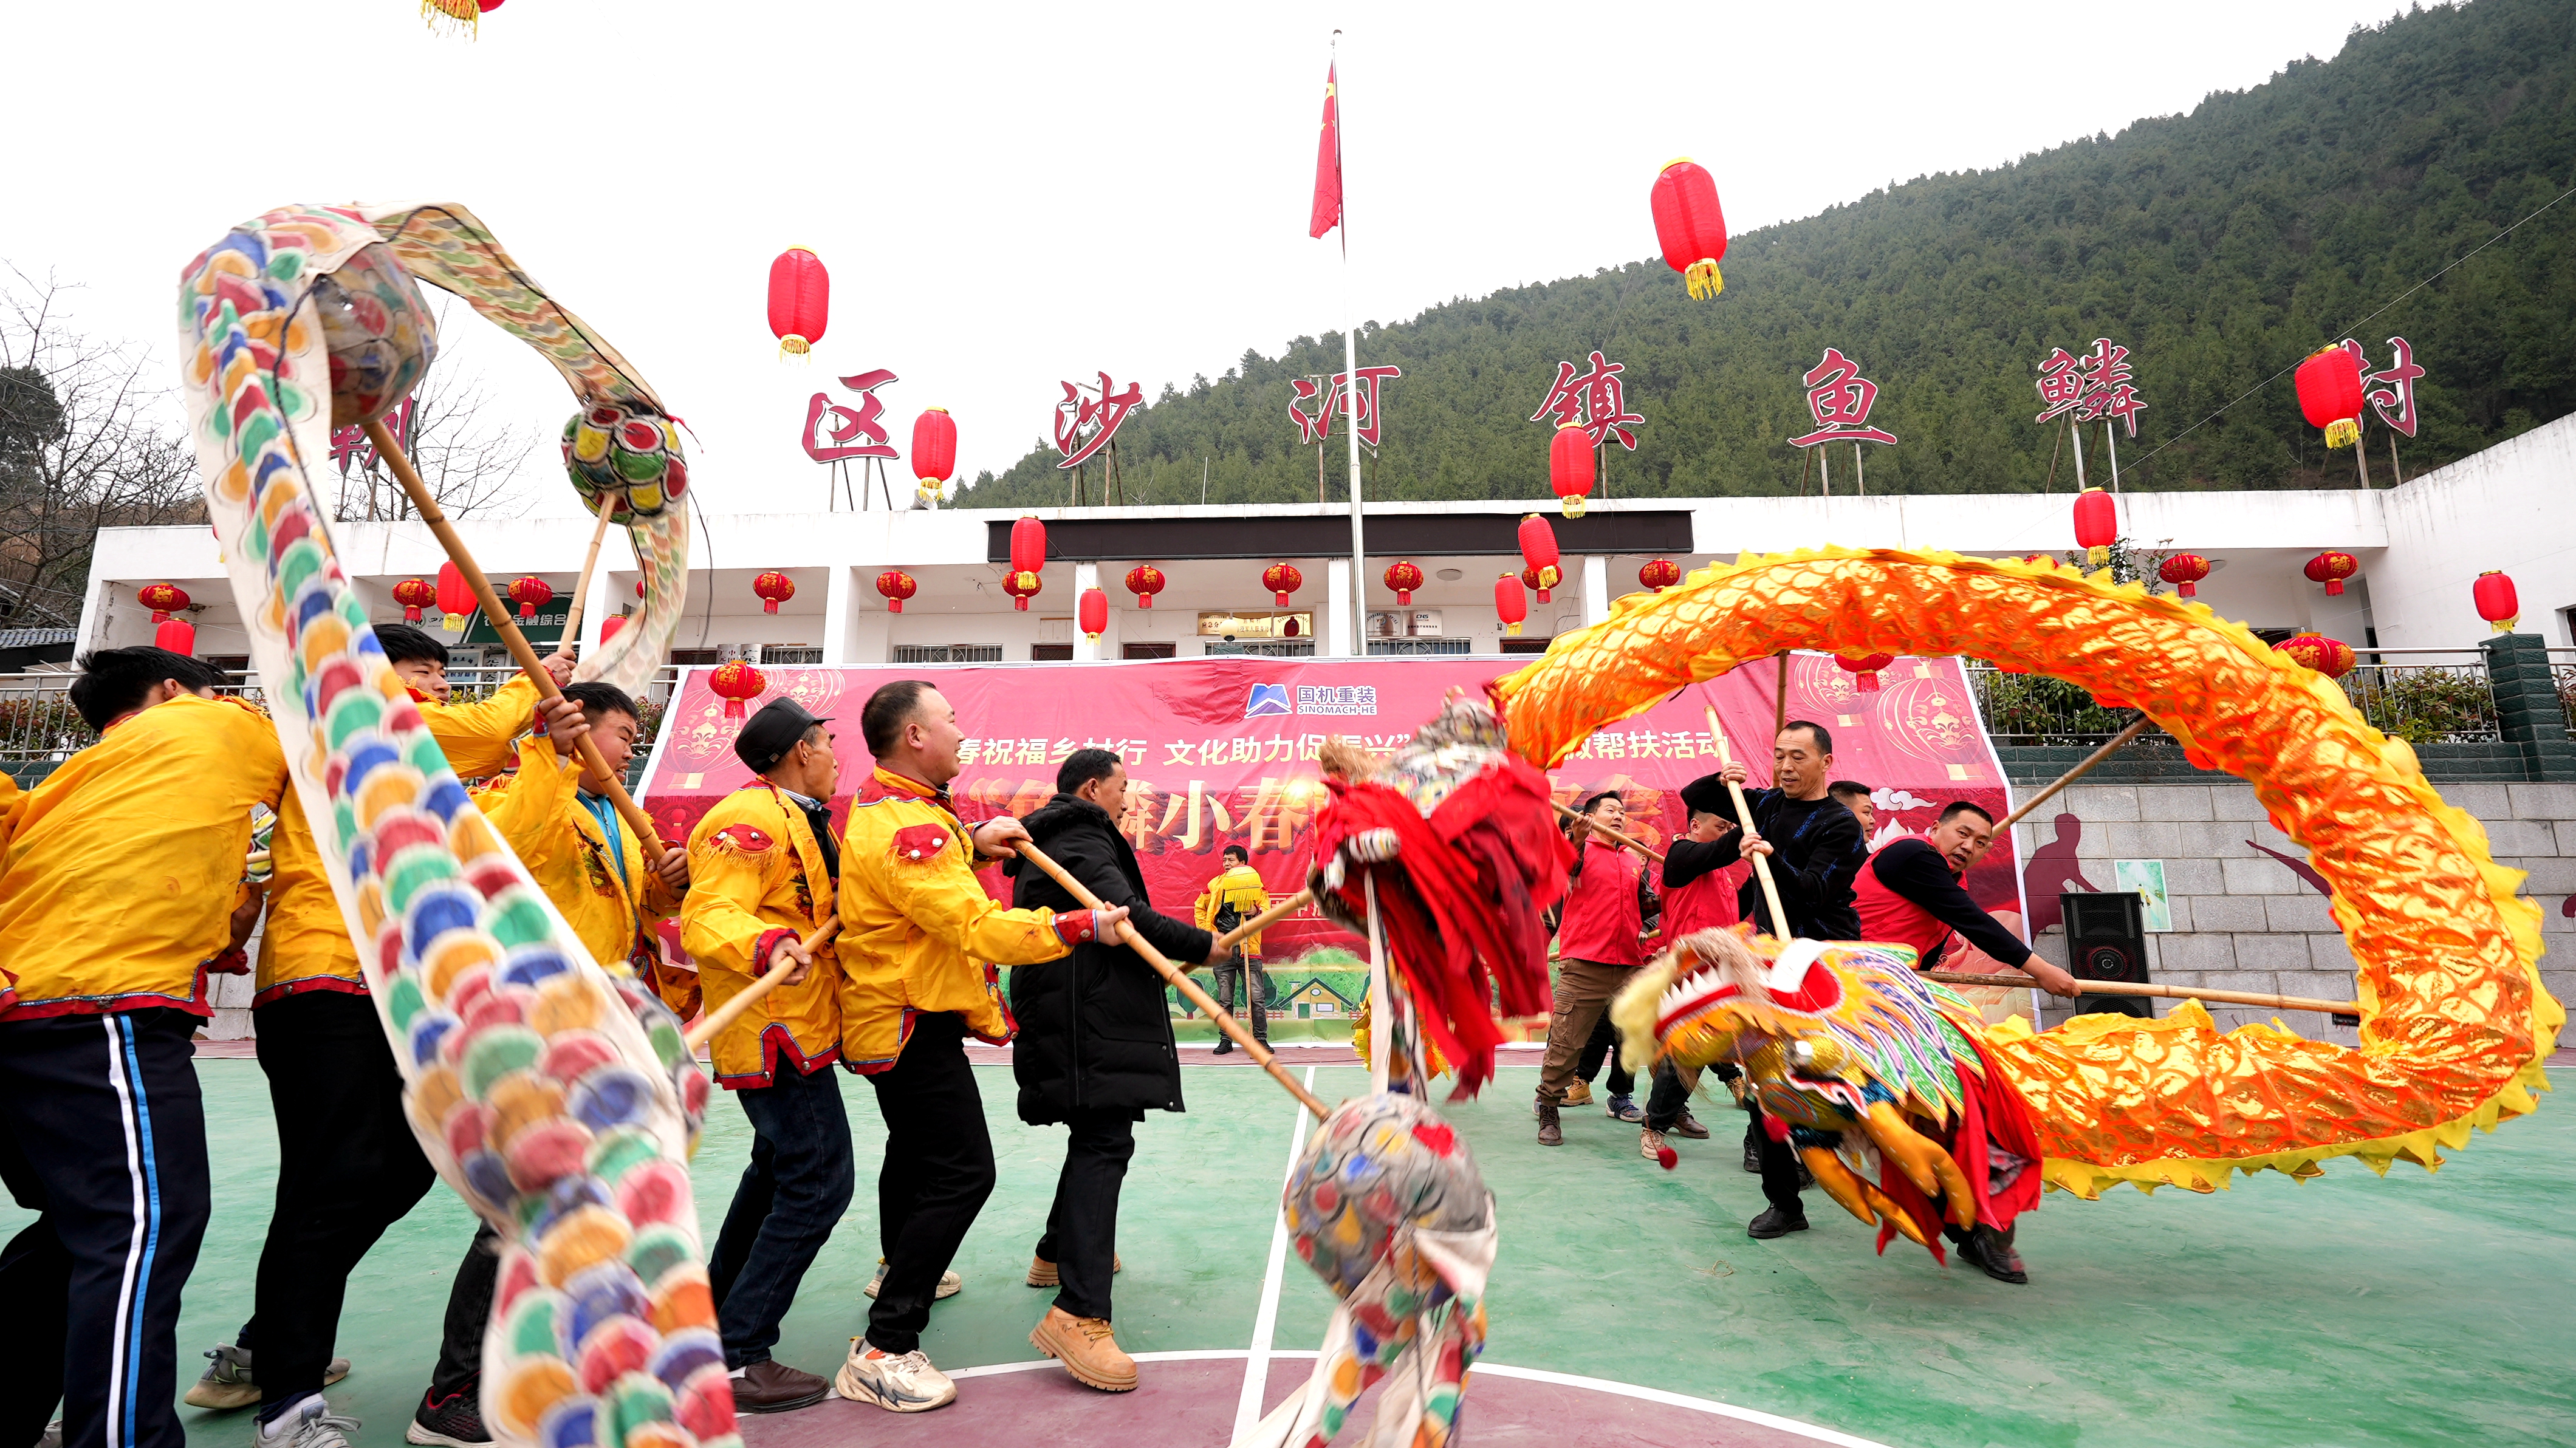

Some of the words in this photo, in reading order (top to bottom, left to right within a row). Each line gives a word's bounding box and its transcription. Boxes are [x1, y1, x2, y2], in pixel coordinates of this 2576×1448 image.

[484, 614, 567, 626] 金融综合
[1298, 686, 1375, 703] 国机重装
